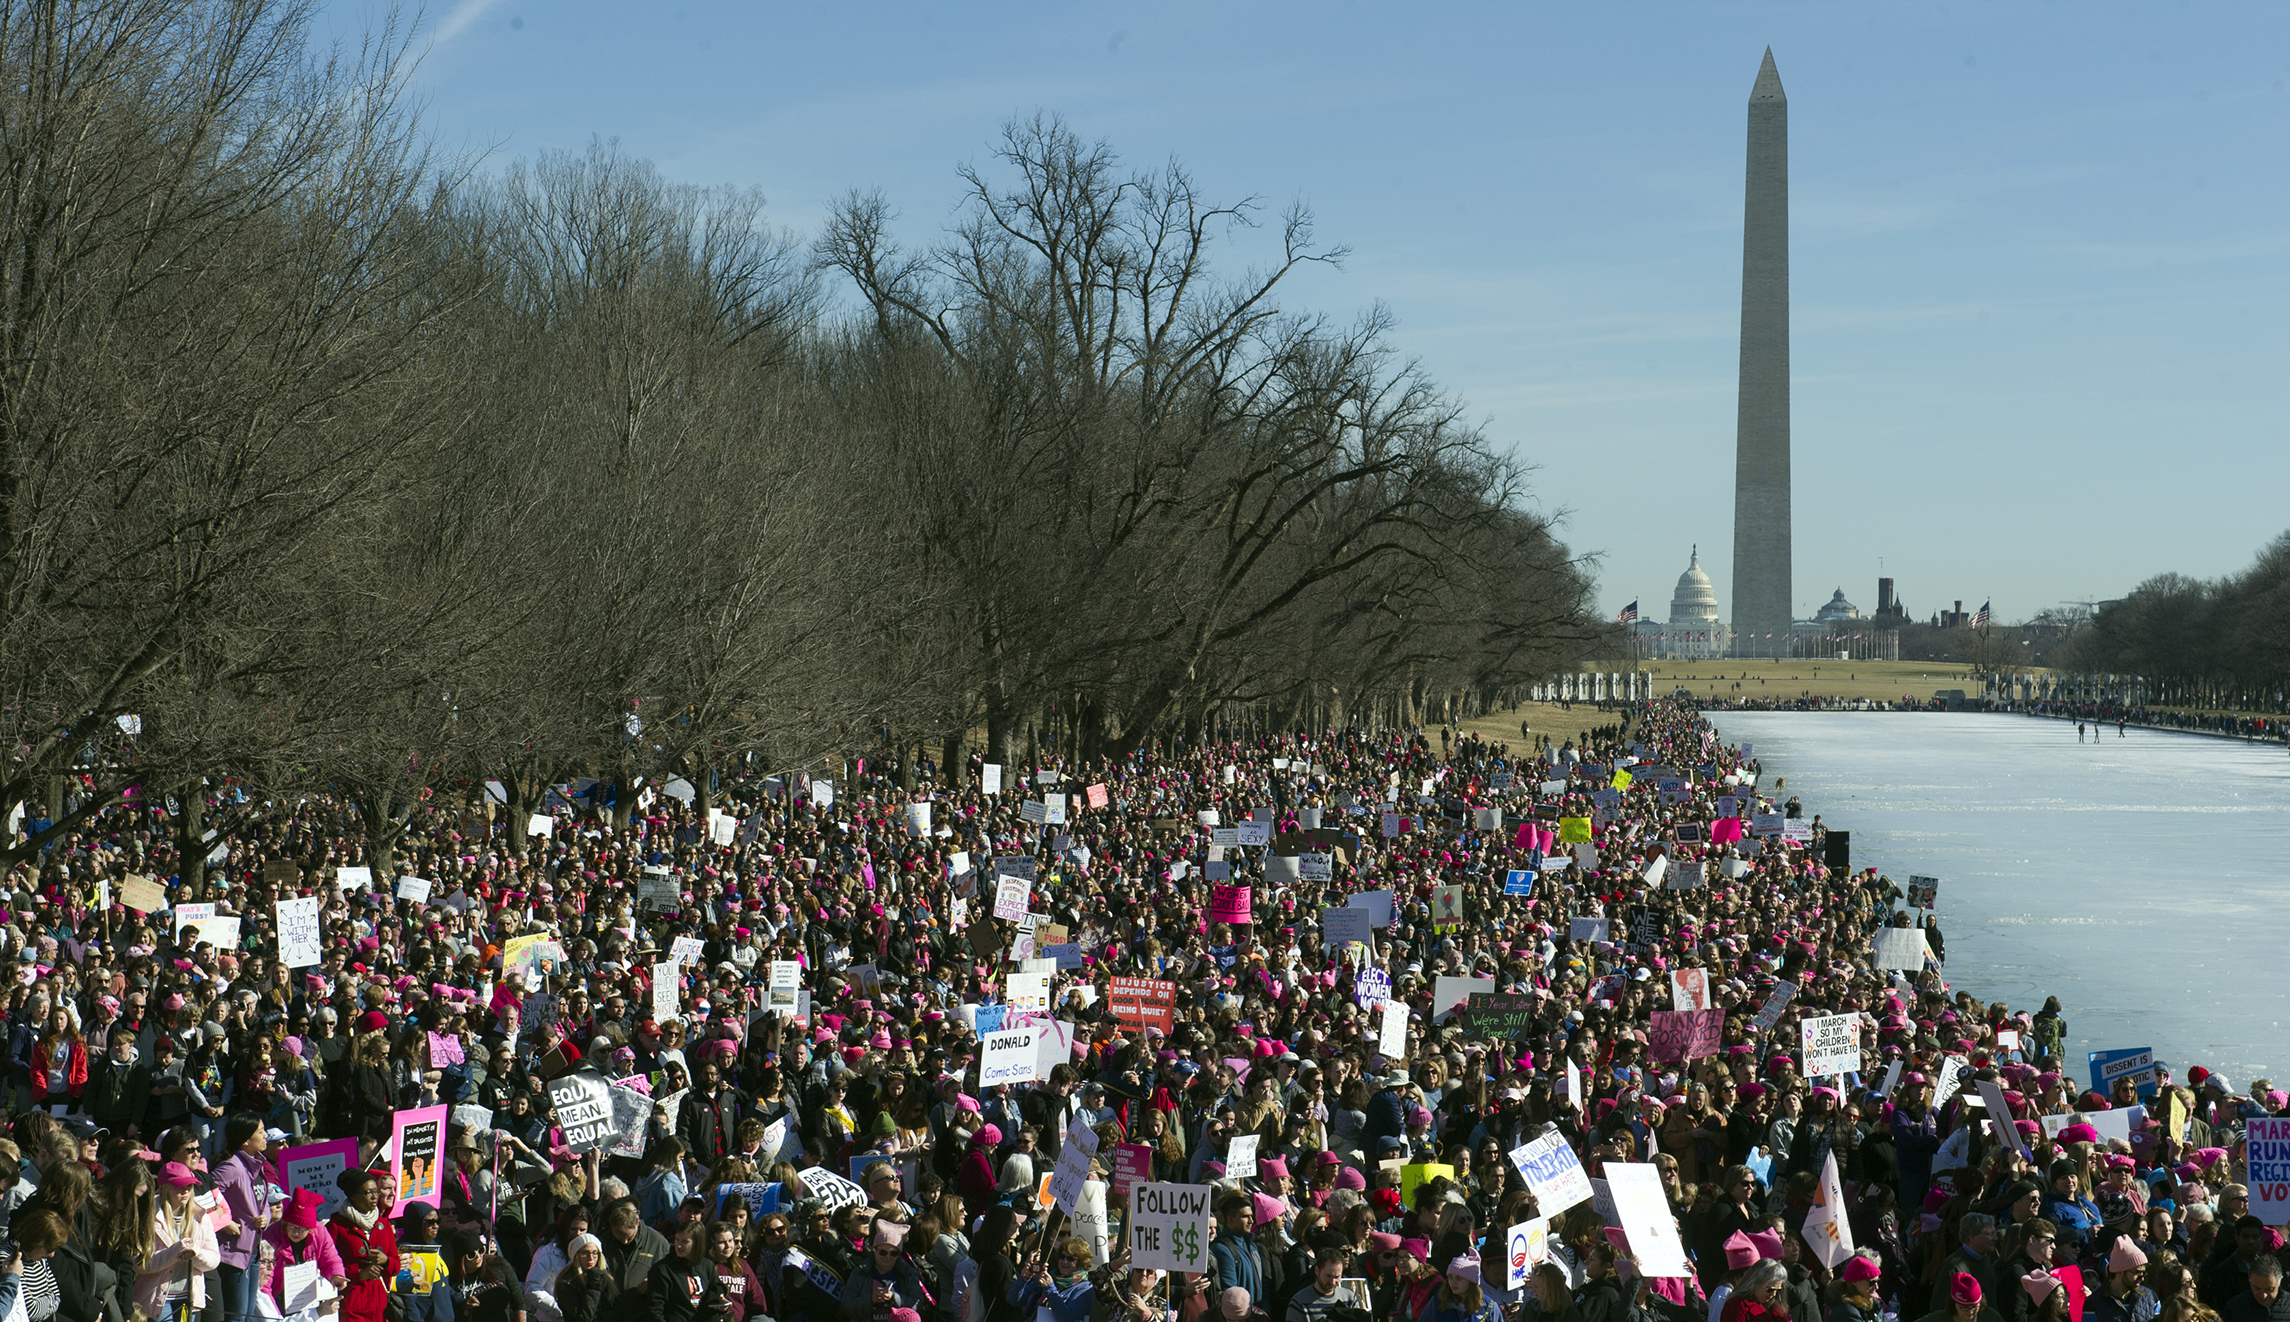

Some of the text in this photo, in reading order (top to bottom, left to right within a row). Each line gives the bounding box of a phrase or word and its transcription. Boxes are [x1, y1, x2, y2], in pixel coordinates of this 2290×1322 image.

[1240, 834, 1264, 844] SEXY
[1302, 856, 1330, 866] WithOut
[641, 872, 680, 883] LONG LIVE
[1216, 888, 1248, 899] WOMEN
[176, 904, 200, 912] THAT'S
[658, 904, 676, 913] SHIT
[998, 898, 1024, 910] EXPECT
[1214, 898, 1236, 909] STRIKE
[994, 906, 1025, 921] RESISTANC
[1632, 905, 1660, 926] WE
[289, 916, 306, 926] I'M
[286, 924, 311, 936] WITH
[1038, 924, 1051, 932] MY
[1628, 926, 1658, 937] ARE
[292, 934, 309, 944] HER
[1044, 934, 1066, 944] PUSSY
[1635, 936, 1662, 944] NOT
[536, 944, 556, 952] TIME
[673, 940, 700, 954] JUSTICE
[1627, 943, 1650, 954] THIN
[657, 965, 674, 976] YOU
[1362, 967, 1388, 985] ELECT
[1116, 978, 1172, 990] INJUSTICE
[1356, 981, 1392, 998] WOMEN
[656, 990, 674, 1002] SEEN
[1114, 986, 1152, 996] DEPENDS
[1014, 996, 1034, 1010] US
[1112, 996, 1170, 1007] GOOD PEOPLE
[1476, 997, 1532, 1010] 1 Year Later
[656, 1002, 677, 1016] NASTY
[1112, 1006, 1166, 1016] BEING QUIET
[1471, 1012, 1528, 1027] We're Still
[1656, 1010, 1716, 1028] MARCH
[1816, 1016, 1847, 1028] I MARCH
[1652, 1026, 1721, 1047] FORWARD
[1820, 1026, 1843, 1037] SO MY
[990, 1036, 1030, 1050] DONALD
[1815, 1035, 1850, 1048] CHILDREN
[1804, 1044, 1858, 1060] WON'T HAVE TO
[2106, 1054, 2148, 1075] DISSENT IS
[984, 1064, 1032, 1080] Comic Sans
[2112, 1072, 2150, 1088] PIOTIC
[560, 1100, 609, 1126] MEANS
[566, 1120, 619, 1146] EQUAL
[760, 1117, 789, 1146] ASTY
[2248, 1120, 2290, 1141] MAR
[1512, 1130, 1561, 1166] WE WILL NOT
[298, 1165, 323, 1175] MOM
[1519, 1144, 1579, 1188] TOLERATE
[2250, 1161, 2290, 1182] REGI
[1115, 1173, 1145, 1182] PARENTHOOD
[1233, 1168, 1252, 1177] SILENT
[304, 1180, 332, 1189] HERO
[1414, 1173, 1444, 1186] MA
[1544, 1178, 1562, 1197] YOUR
[1560, 1171, 1578, 1188] HATE
[817, 1178, 860, 1206] ERA
[1137, 1186, 1206, 1217] FOLLOW
[1135, 1220, 1200, 1266] THE $$
[718, 1276, 746, 1286] FUTURE
[804, 1258, 844, 1299] RESPE
